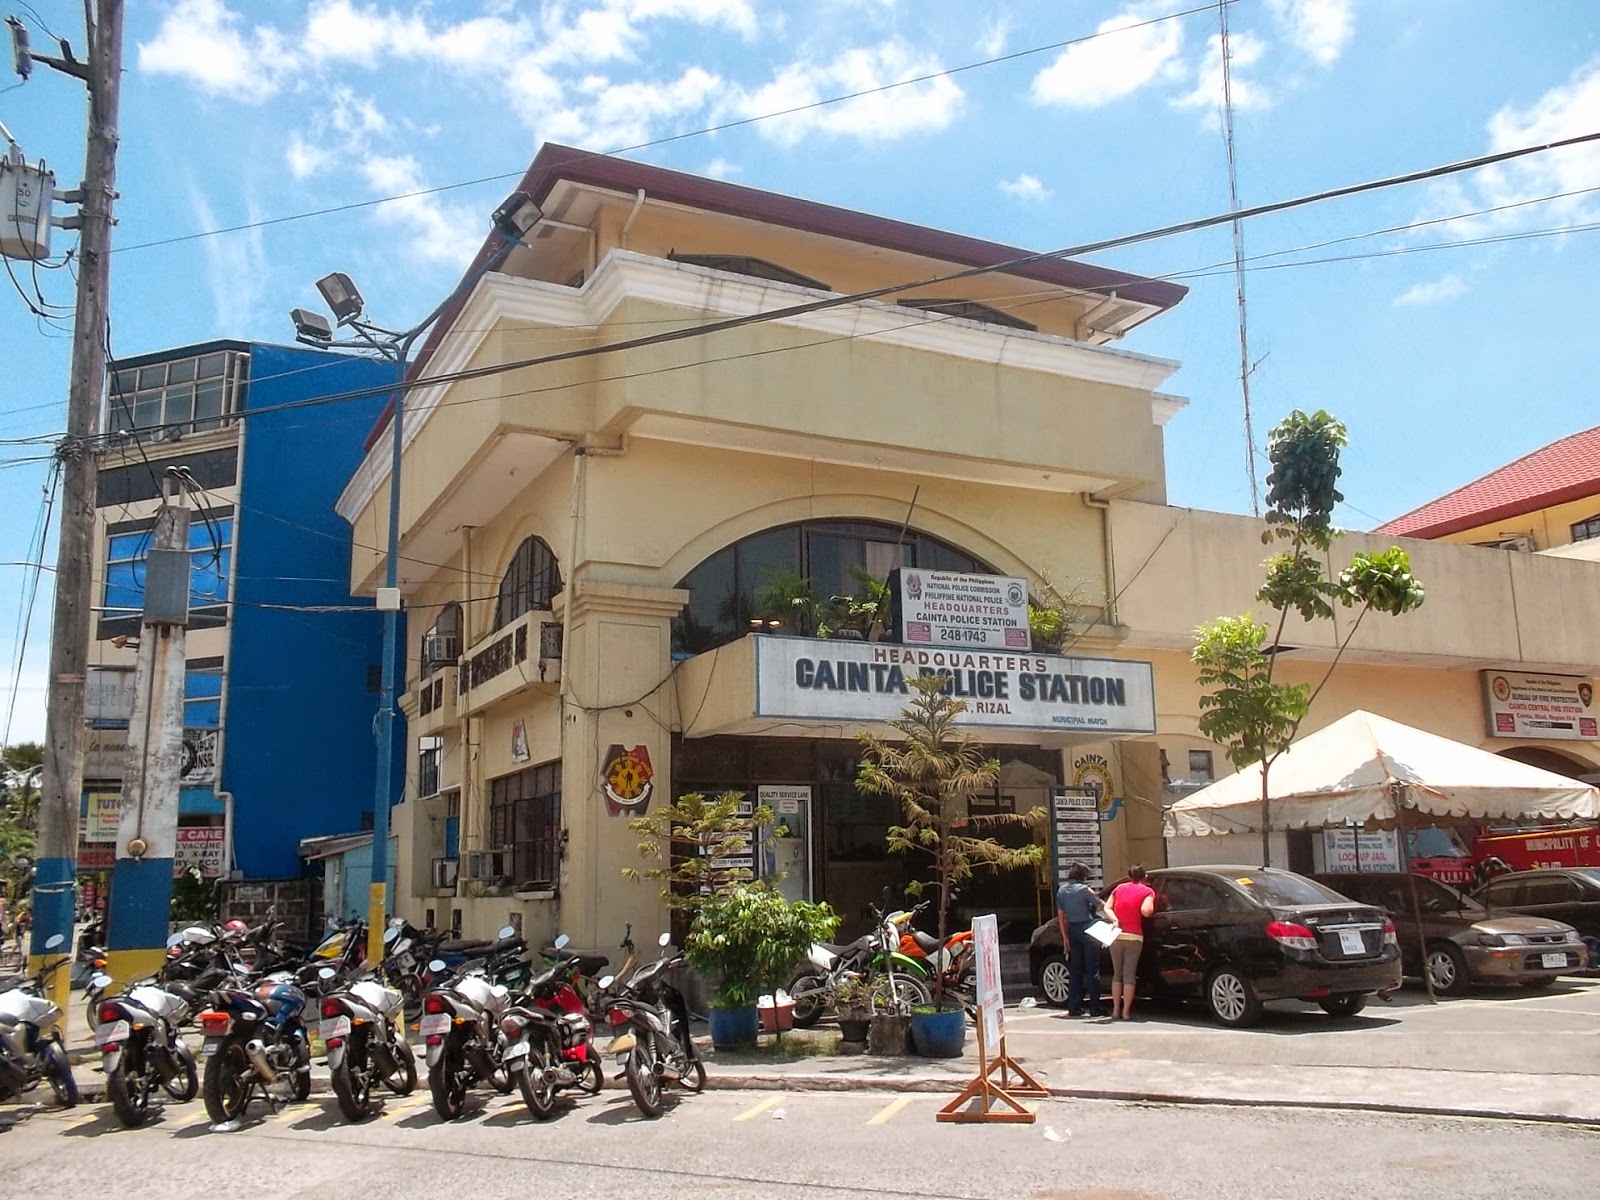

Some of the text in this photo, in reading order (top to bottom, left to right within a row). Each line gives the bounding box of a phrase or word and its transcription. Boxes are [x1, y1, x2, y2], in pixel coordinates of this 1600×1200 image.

[968, 577, 995, 585] Philippines
[926, 582, 950, 590] NATIONAL
[970, 585, 1000, 594] COMMISSION
[924, 592, 1003, 604] PHILIPPINE NATIONAL POLICE
[924, 602, 1010, 616] HEADQUARTERS
[916, 612, 1018, 628] CAINTA POLICE STATION
[874, 648, 1047, 672] HEADQUARTERS
[795, 658, 909, 695] CAINTA
[1018, 672, 1127, 707] STATION
[1512, 693, 1532, 701] BUREAU
[1550, 696, 1579, 704] PROTECTION
[977, 702, 1012, 714] RIZAL
[1528, 704, 1550, 712] CENTRAL
[1052, 716, 1086, 724] MUNICIPAL
[1074, 754, 1108, 768] CAINTA
[187, 830, 224, 840] CARE
[1525, 837, 1574, 851] MUNICIPALITY
[1580, 836, 1590, 848] OF
[1372, 852, 1386, 860] JAIL
[1372, 864, 1396, 872] STATION
